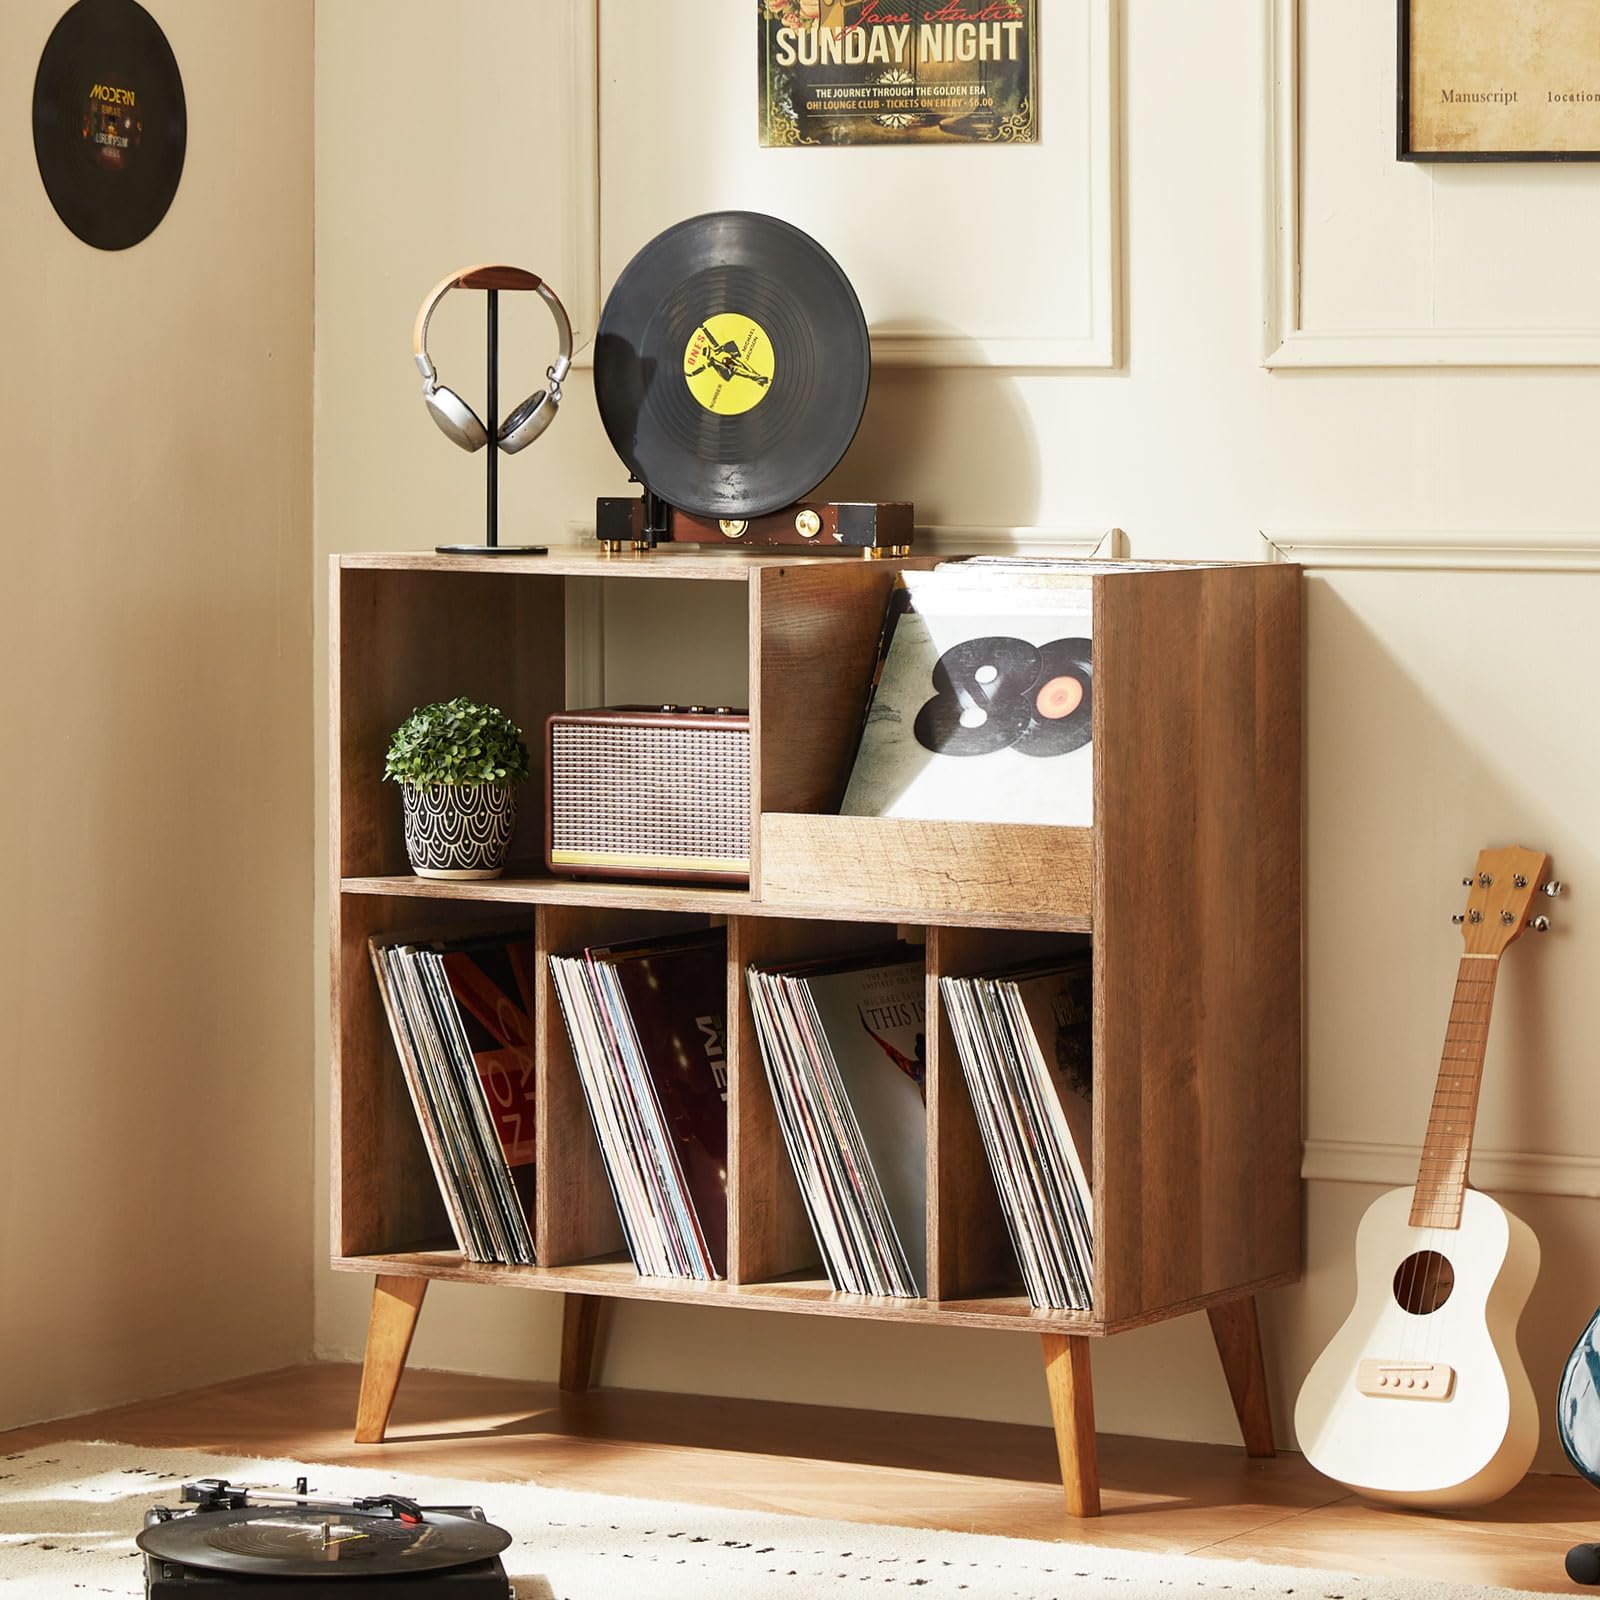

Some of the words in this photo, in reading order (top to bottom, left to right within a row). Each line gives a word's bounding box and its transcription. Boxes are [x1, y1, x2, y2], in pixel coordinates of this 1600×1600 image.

[776, 24, 910, 66] SUNDAY
[920, 22, 1024, 64] NIGHT
[90, 84, 135, 106] MODERN
[806, 100, 822, 110] OH!
[823, 100, 857, 110] LOUNGE
[858, 100, 880, 109] CLUB
[886, 99, 918, 109] TICKETS
[920, 98, 934, 108] ON
[935, 98, 962, 108] ENTRY
[968, 98, 993, 107] $6.00
[816, 89, 832, 98] THE
[833, 88, 872, 98] JOURNEY
[872, 88, 913, 97] THROUGH
[914, 87, 932, 97] THE
[934, 86, 967, 96] GOLDEN
[970, 86, 986, 95] ERA
[1441, 88, 1518, 105] Manuscript
[688, 334, 705, 366] ONES
[742, 328, 756, 352] MICHAEL
[746, 336, 758, 360] JACKSON
[709, 384, 722, 408] NUMBER
[866, 1003, 912, 1030] THIS
